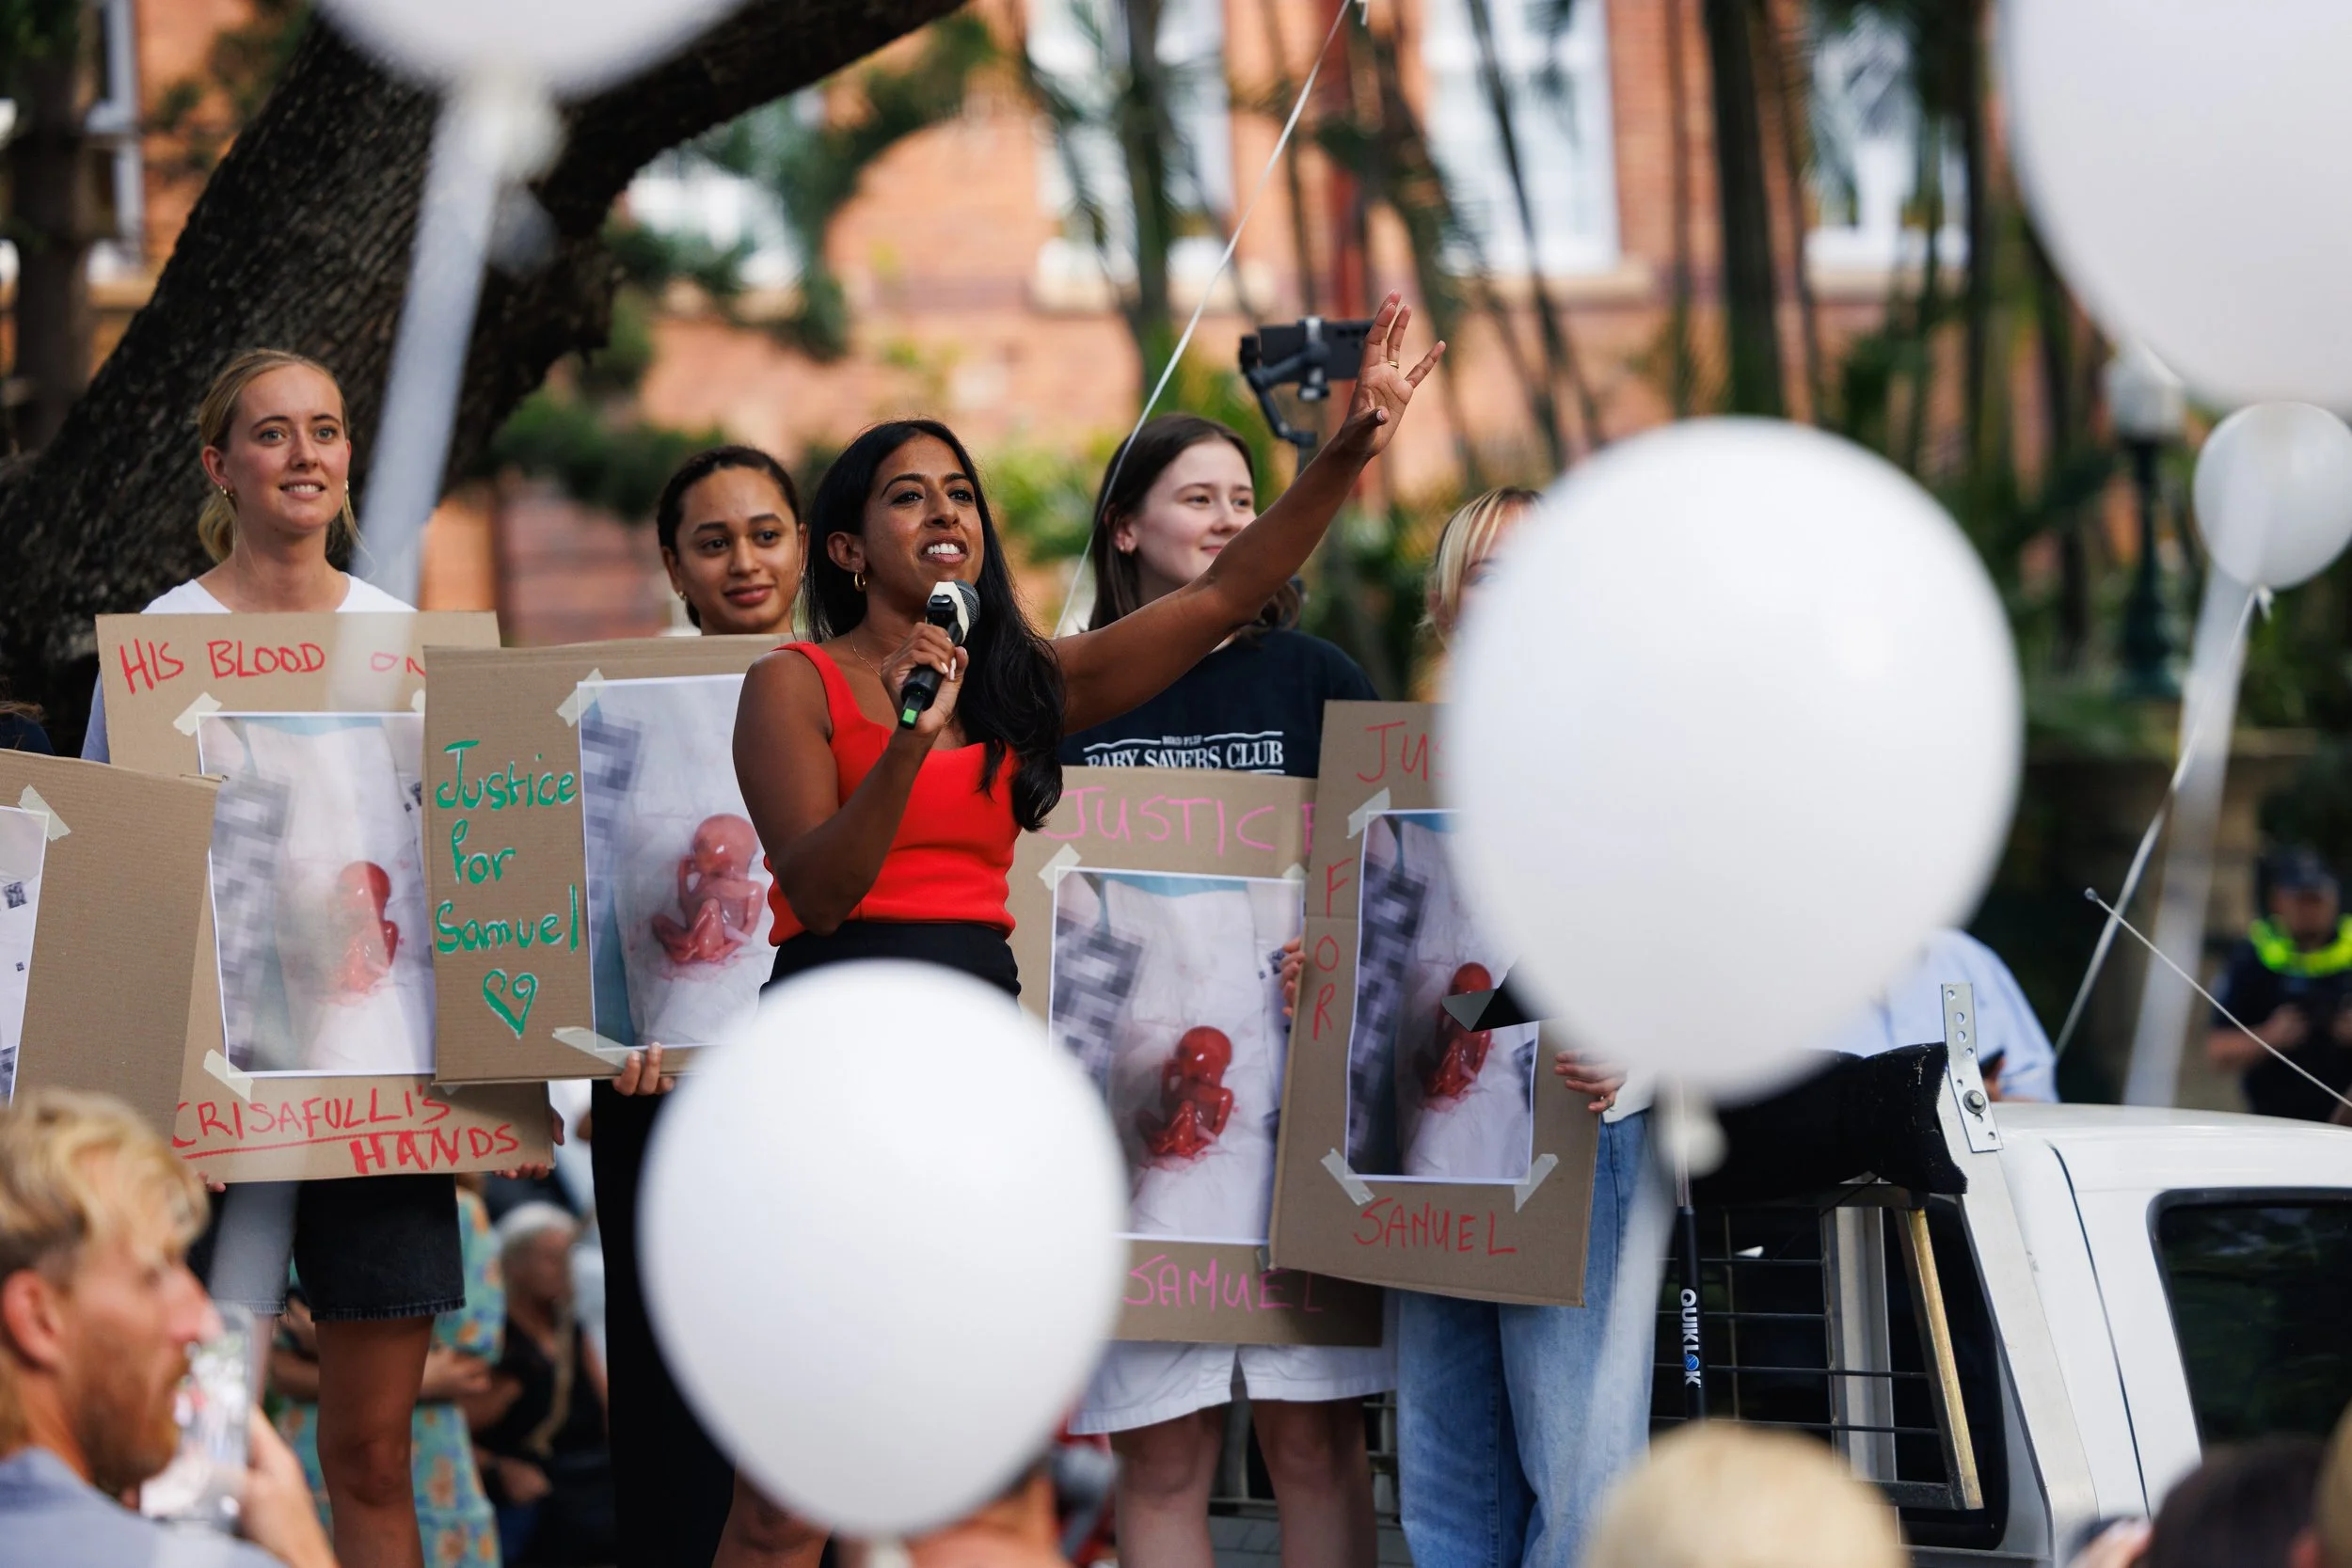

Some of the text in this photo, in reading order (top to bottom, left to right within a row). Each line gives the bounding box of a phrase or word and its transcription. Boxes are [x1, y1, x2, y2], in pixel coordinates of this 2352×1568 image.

[119, 639, 184, 694] HIS
[207, 641, 326, 678] BLOOD
[436, 740, 577, 810] Justice
[1227, 740, 1283, 768] CLUB
[452, 819, 516, 884] for
[436, 884, 579, 954] Samuel
[1312, 858, 1355, 1040] FOR
[349, 1124, 519, 1174] HANDS
[1122, 1255, 1324, 1313] SAMUEL
